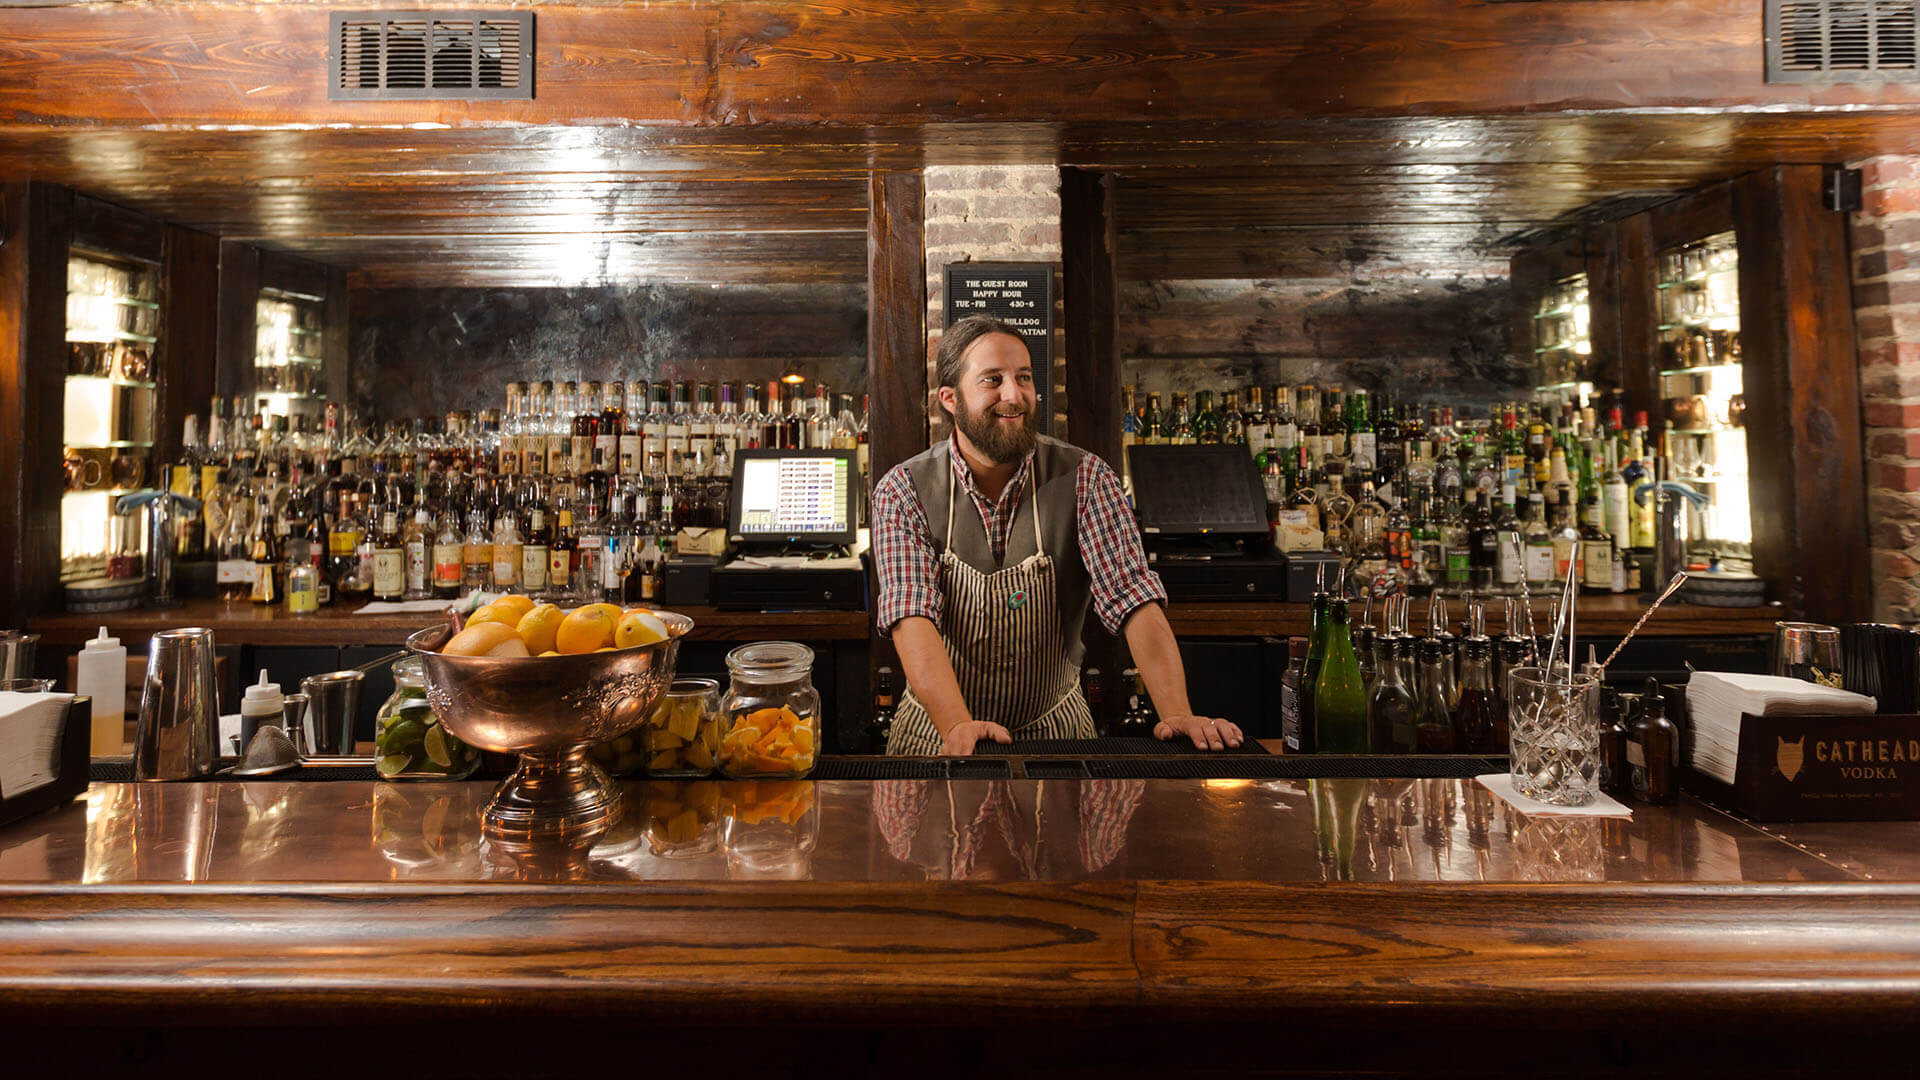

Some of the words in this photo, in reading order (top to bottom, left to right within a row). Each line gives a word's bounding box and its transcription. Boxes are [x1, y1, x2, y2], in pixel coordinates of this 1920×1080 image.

[965, 280, 980, 288] THE
[982, 280, 1006, 288] GUEST
[1008, 280, 1028, 288] ROOM
[973, 290, 998, 298] HAPPY
[1002, 290, 1022, 298] HOUR
[1816, 740, 1920, 762] CATHEAD
[1841, 767, 1897, 779] VODKA
